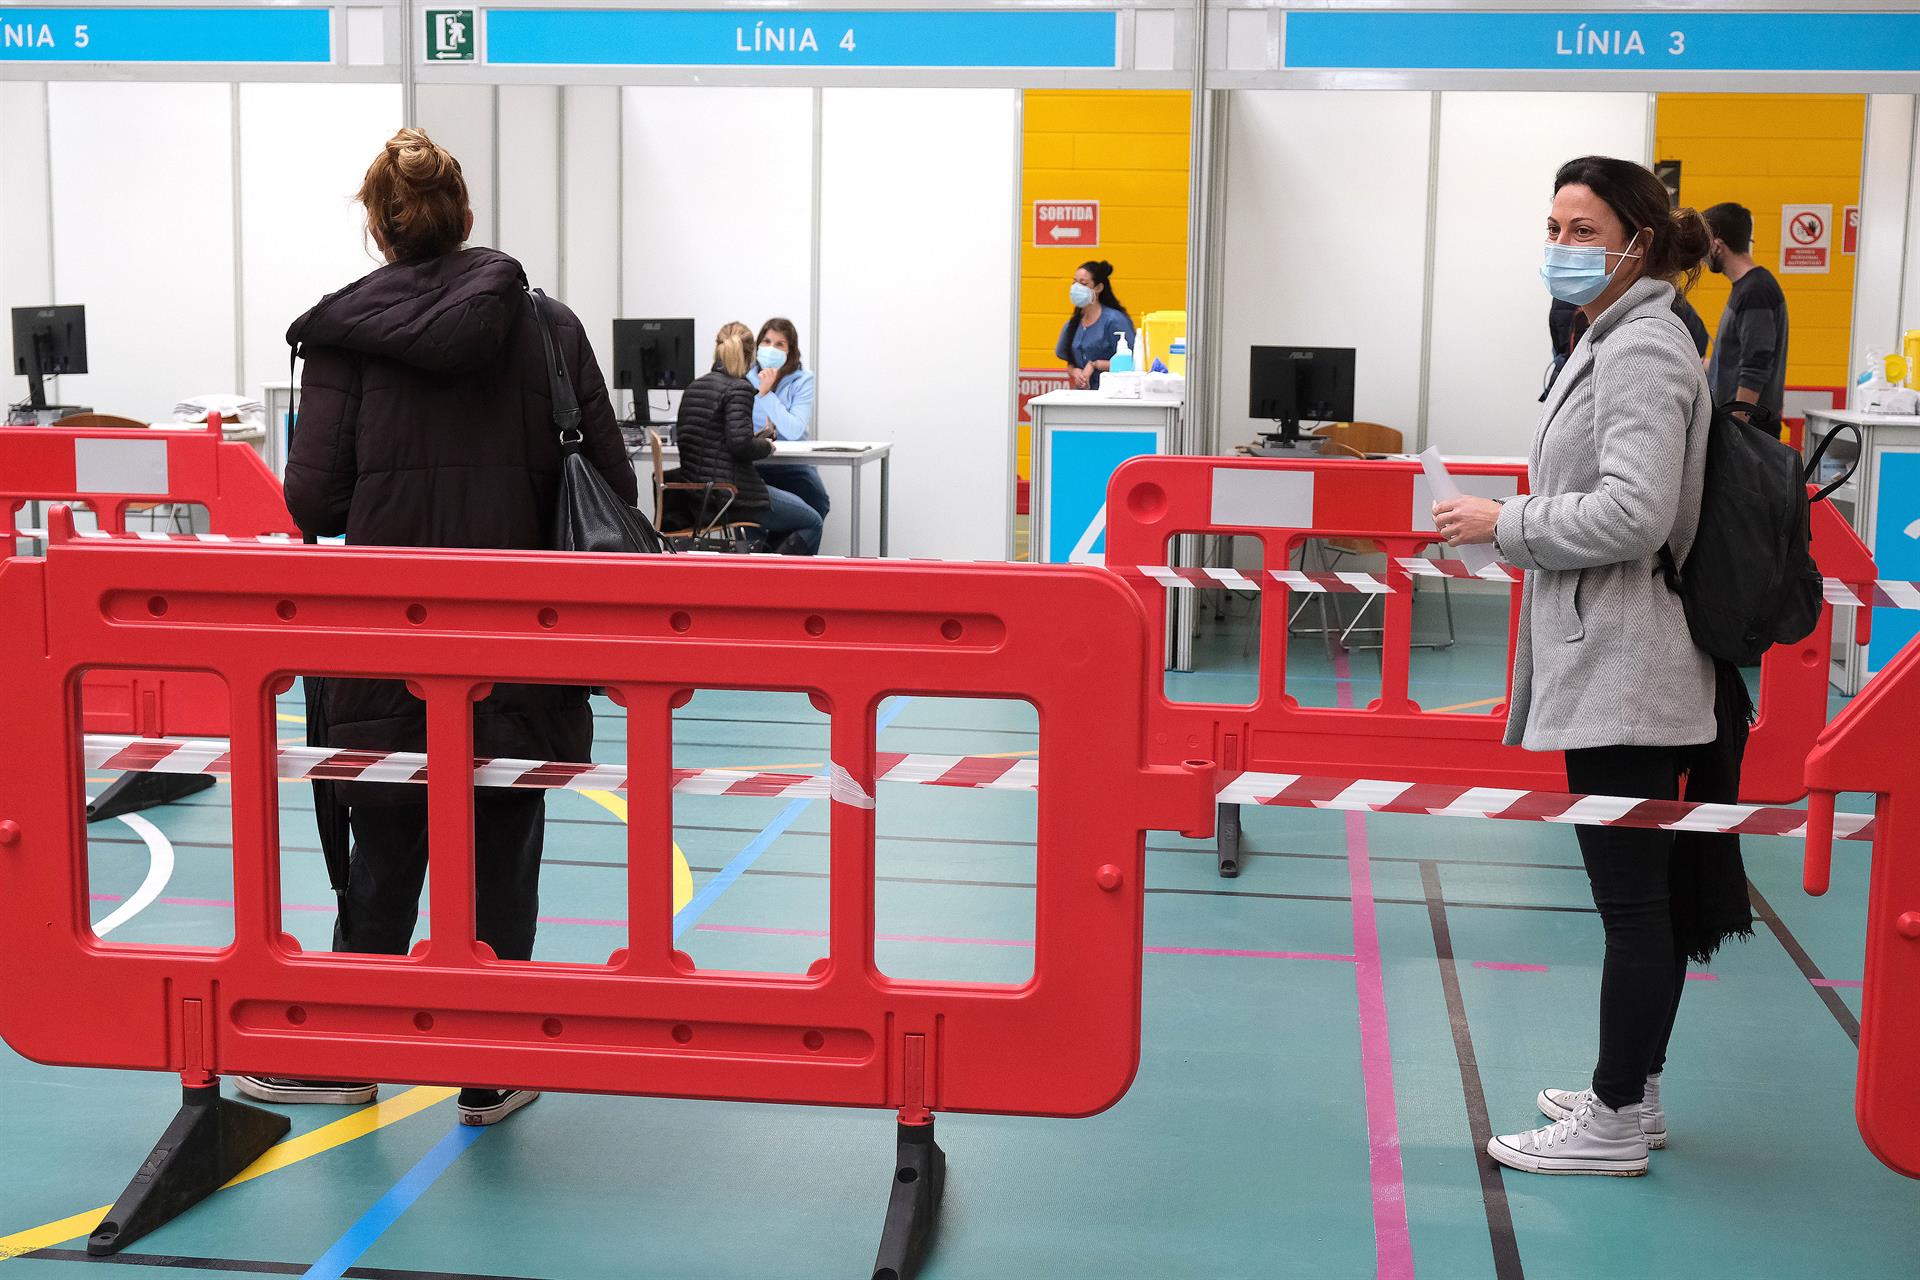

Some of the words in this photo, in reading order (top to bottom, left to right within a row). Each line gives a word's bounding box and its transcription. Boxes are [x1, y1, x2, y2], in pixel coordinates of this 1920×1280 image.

[0, 17, 55, 48] NIA
[74, 24, 89, 48] 5
[736, 20, 819, 52] LÍNIA
[839, 28, 856, 52] 4
[1556, 22, 1645, 55] LÍNIA
[1668, 30, 1685, 55] 3
[1039, 206, 1093, 221] SORTIDA
[1018, 380, 1071, 396] ORTIDA
